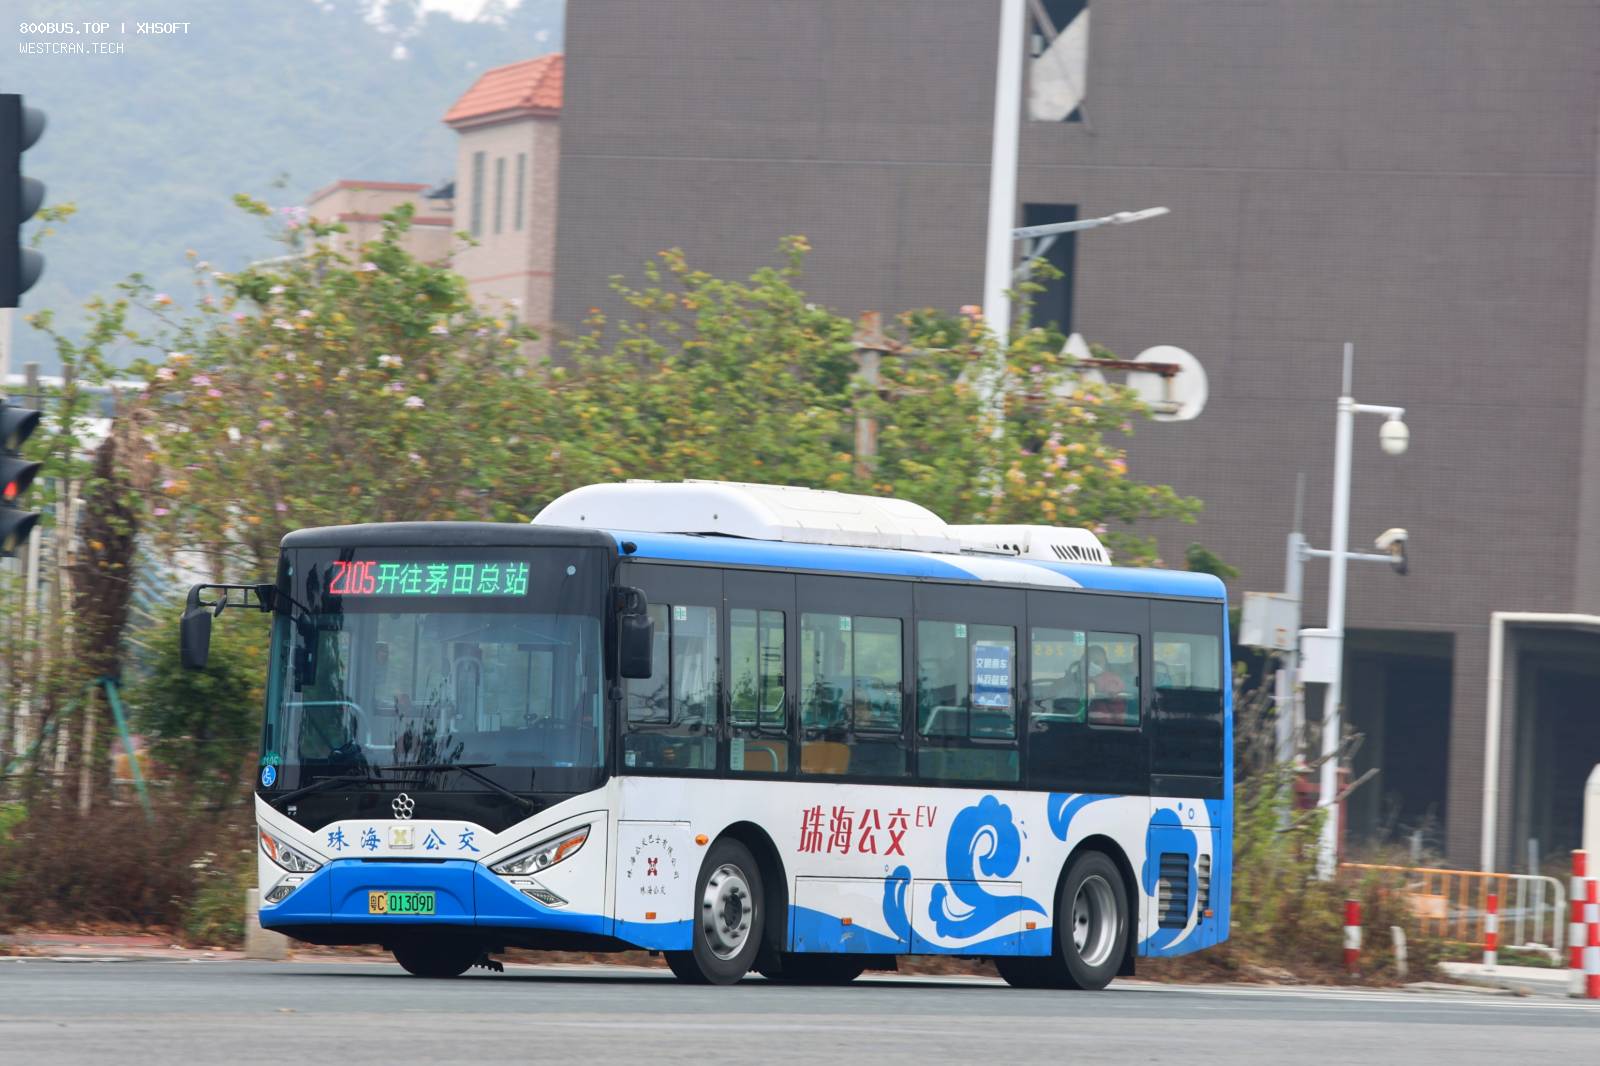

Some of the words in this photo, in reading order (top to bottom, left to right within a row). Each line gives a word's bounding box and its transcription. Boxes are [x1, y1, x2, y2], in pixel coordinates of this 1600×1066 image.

[376, 562, 529, 595] 开往茅田总站
[797, 804, 910, 856] 珠海公交
[915, 805, 937, 828] EV
[389, 895, 433, 911] 01309D
